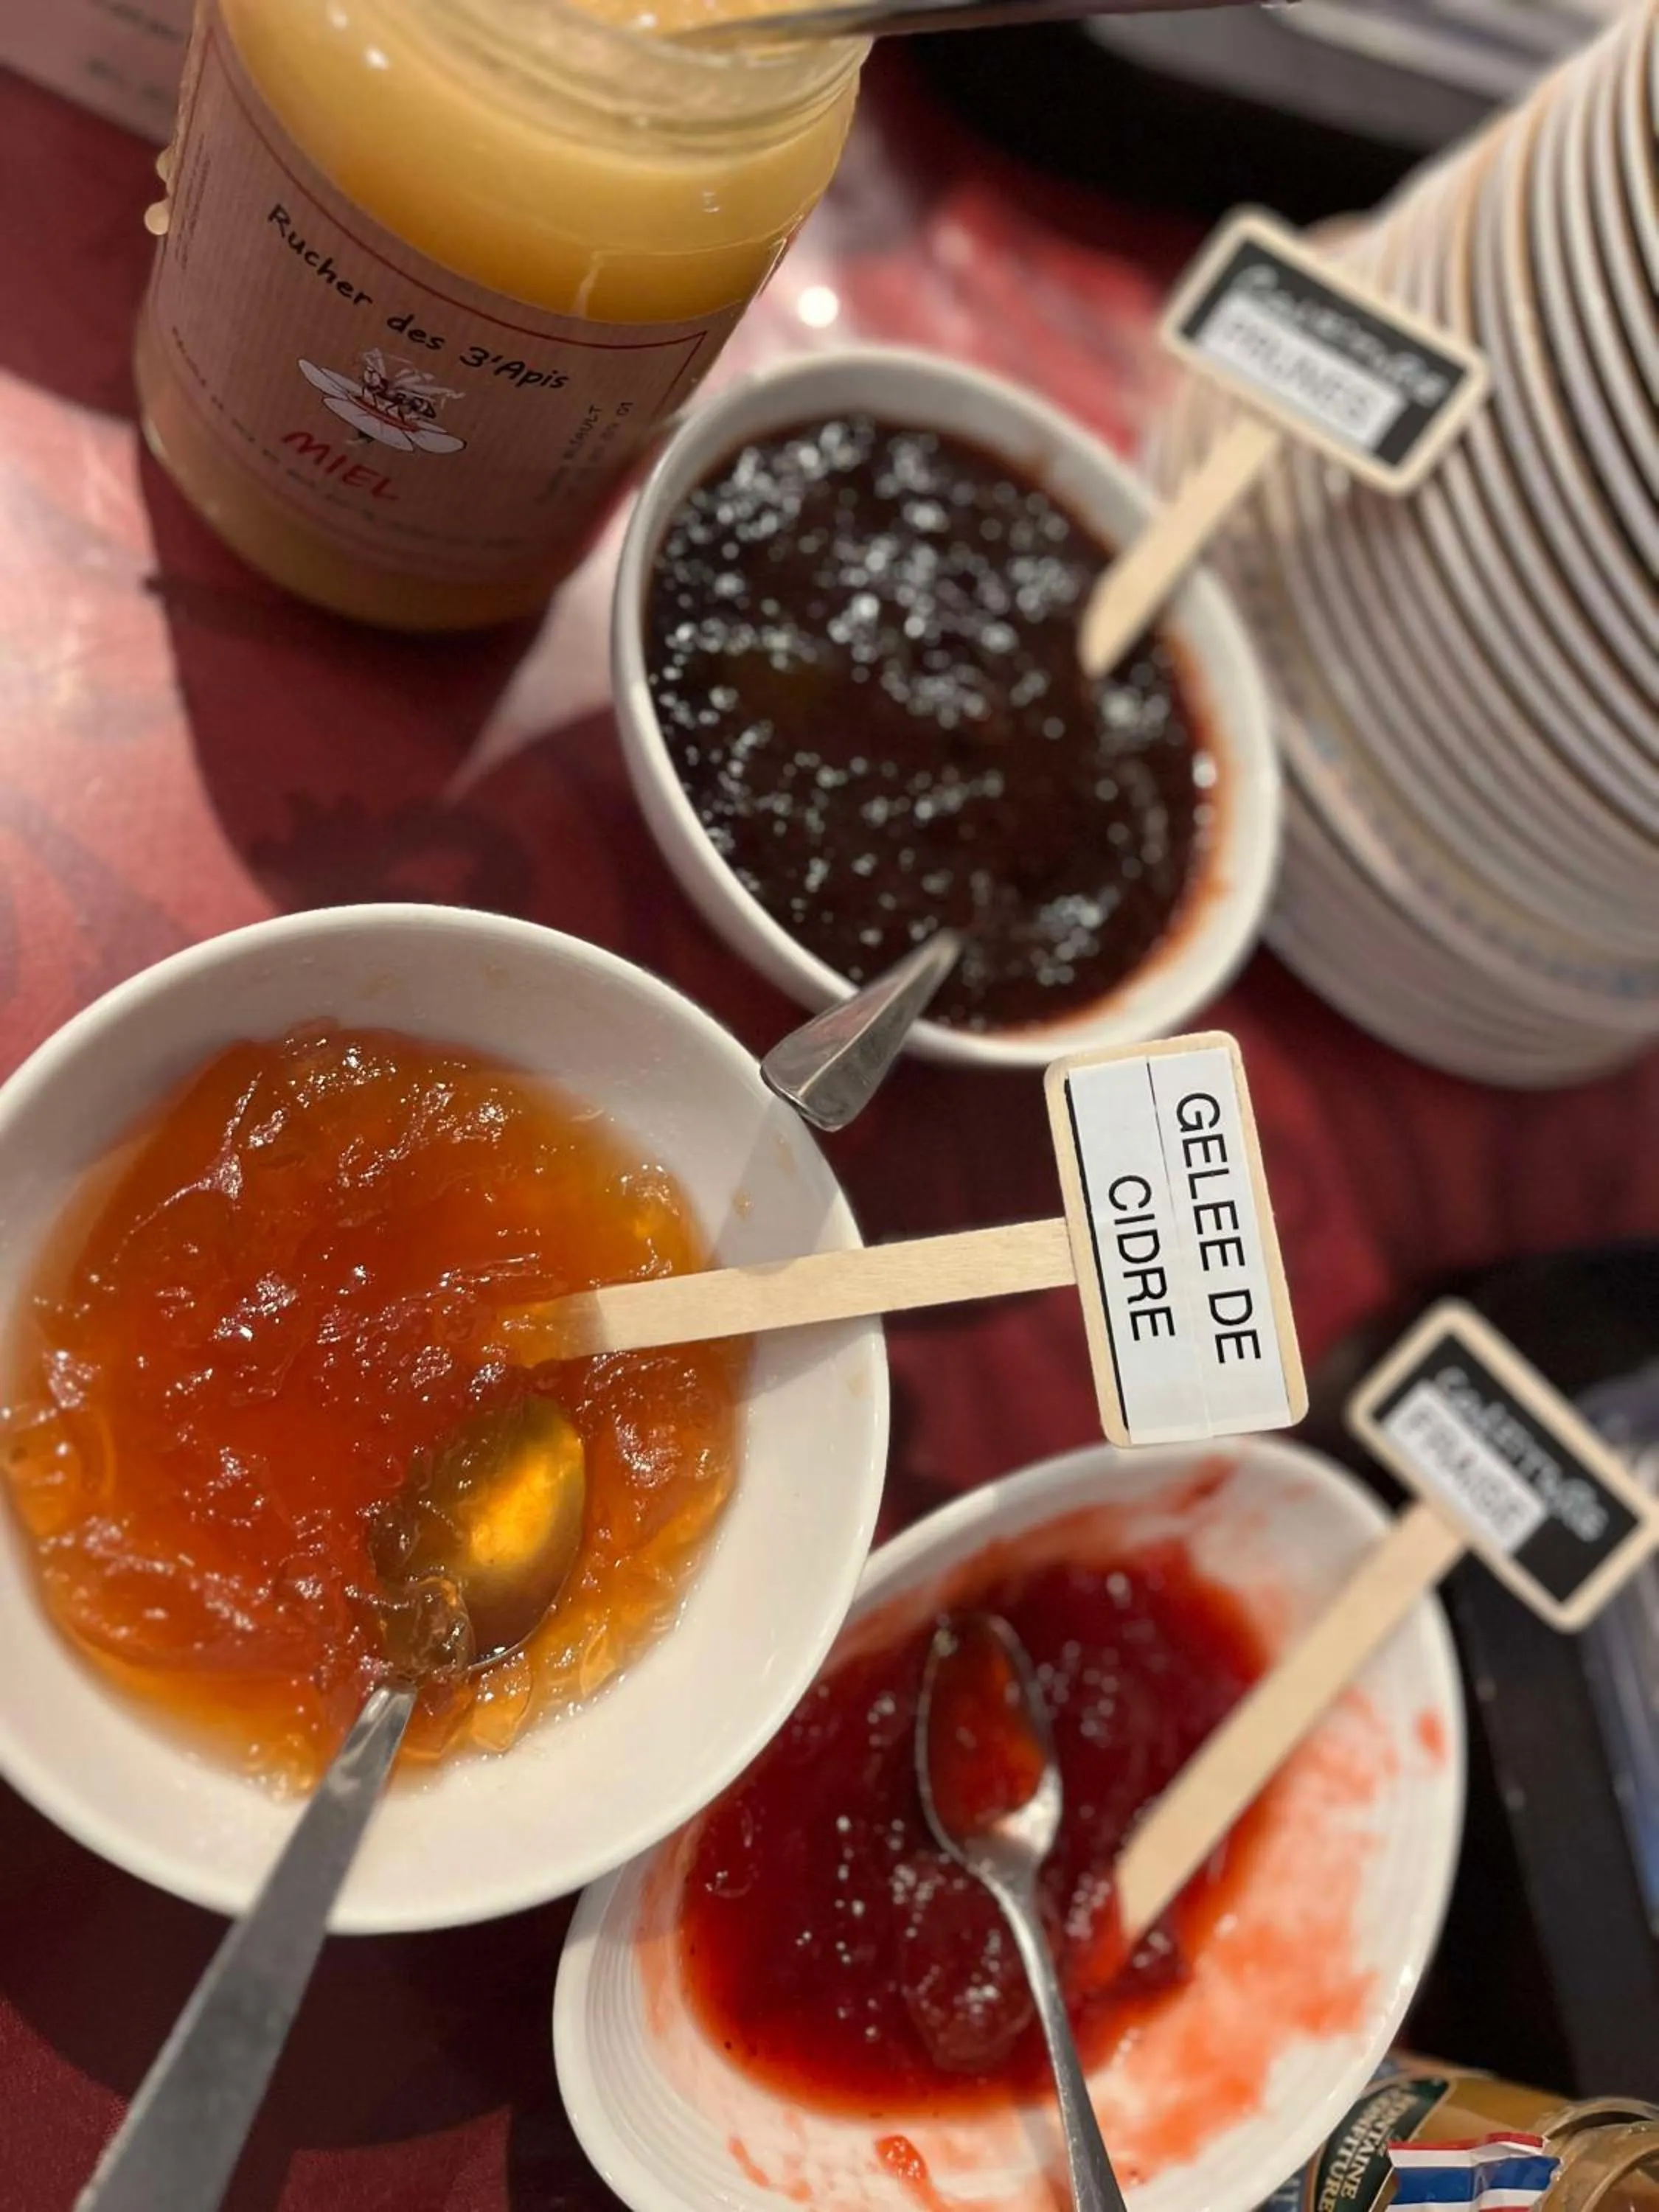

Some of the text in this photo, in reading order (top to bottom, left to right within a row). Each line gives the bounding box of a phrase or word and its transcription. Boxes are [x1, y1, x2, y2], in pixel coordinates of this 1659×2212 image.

[267, 204, 570, 389] Rucher des 3'Apis
[282, 431, 400, 501] MIEL
[1108, 1175, 1176, 1342] CIDRE
[1176, 1092, 1262, 1365] GELEE DE
